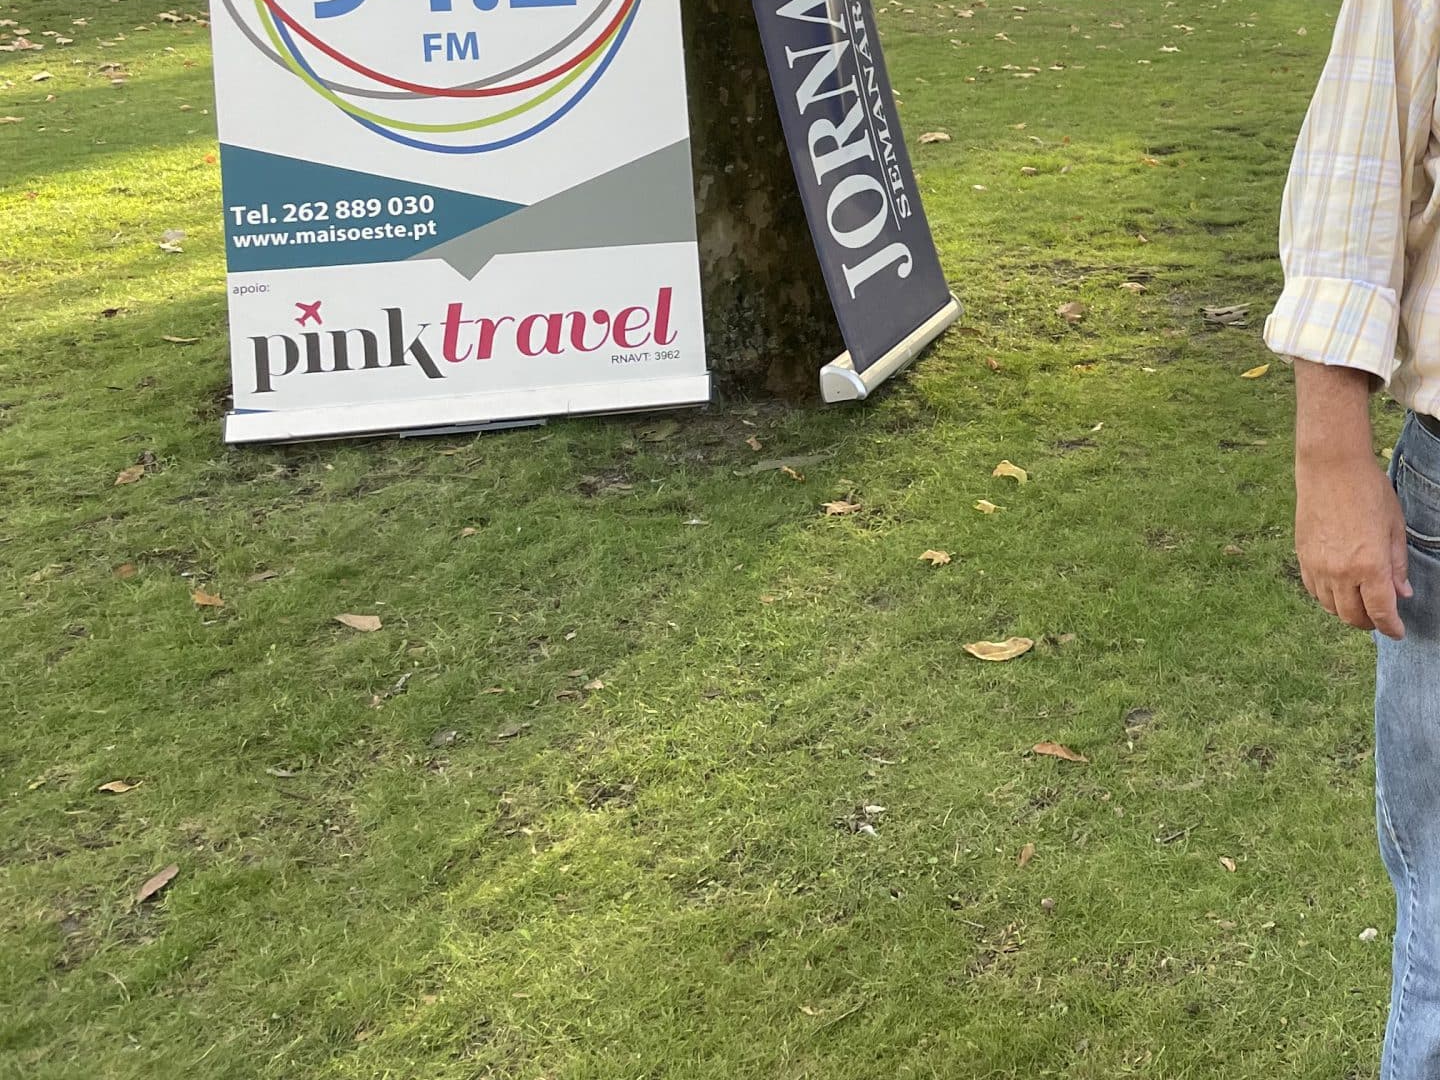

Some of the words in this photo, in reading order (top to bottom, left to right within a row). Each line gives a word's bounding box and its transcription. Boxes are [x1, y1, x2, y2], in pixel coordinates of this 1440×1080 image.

[423, 31, 480, 62] FM
[230, 203, 277, 225] Tel.
[282, 201, 330, 223] 262
[335, 199, 382, 219] 889
[387, 194, 435, 216] 030
[233, 220, 437, 248] www.maisoeste.pt
[232, 282, 270, 296] apoio:
[611, 352, 651, 364] RNAVT:
[654, 349, 681, 361] 3962
